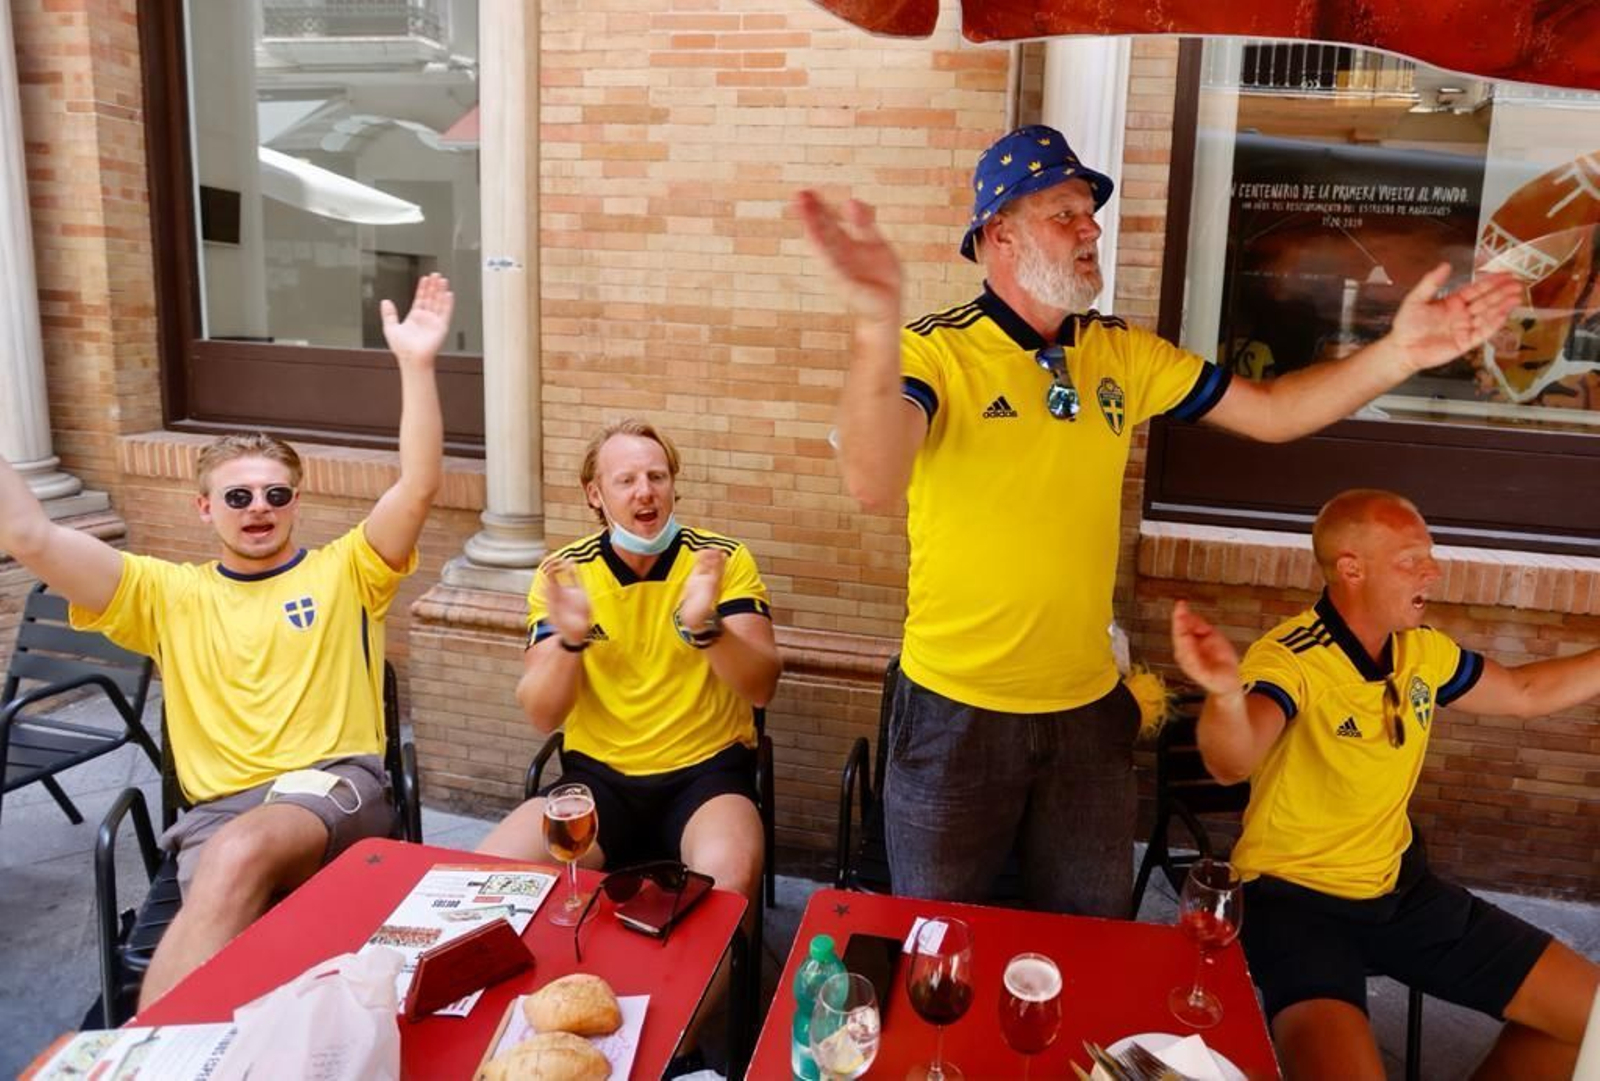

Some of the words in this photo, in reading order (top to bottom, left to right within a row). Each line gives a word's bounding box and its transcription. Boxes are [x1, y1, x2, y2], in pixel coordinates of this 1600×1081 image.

[1239, 183, 1299, 200] CENTENARIO
[1303, 184, 1315, 200] DE
[1318, 184, 1331, 200] LA
[1332, 184, 1376, 201] PRIMERA
[1378, 184, 1415, 202] VUELTA
[1417, 186, 1429, 202] AL
[982, 409, 1018, 418] adidas
